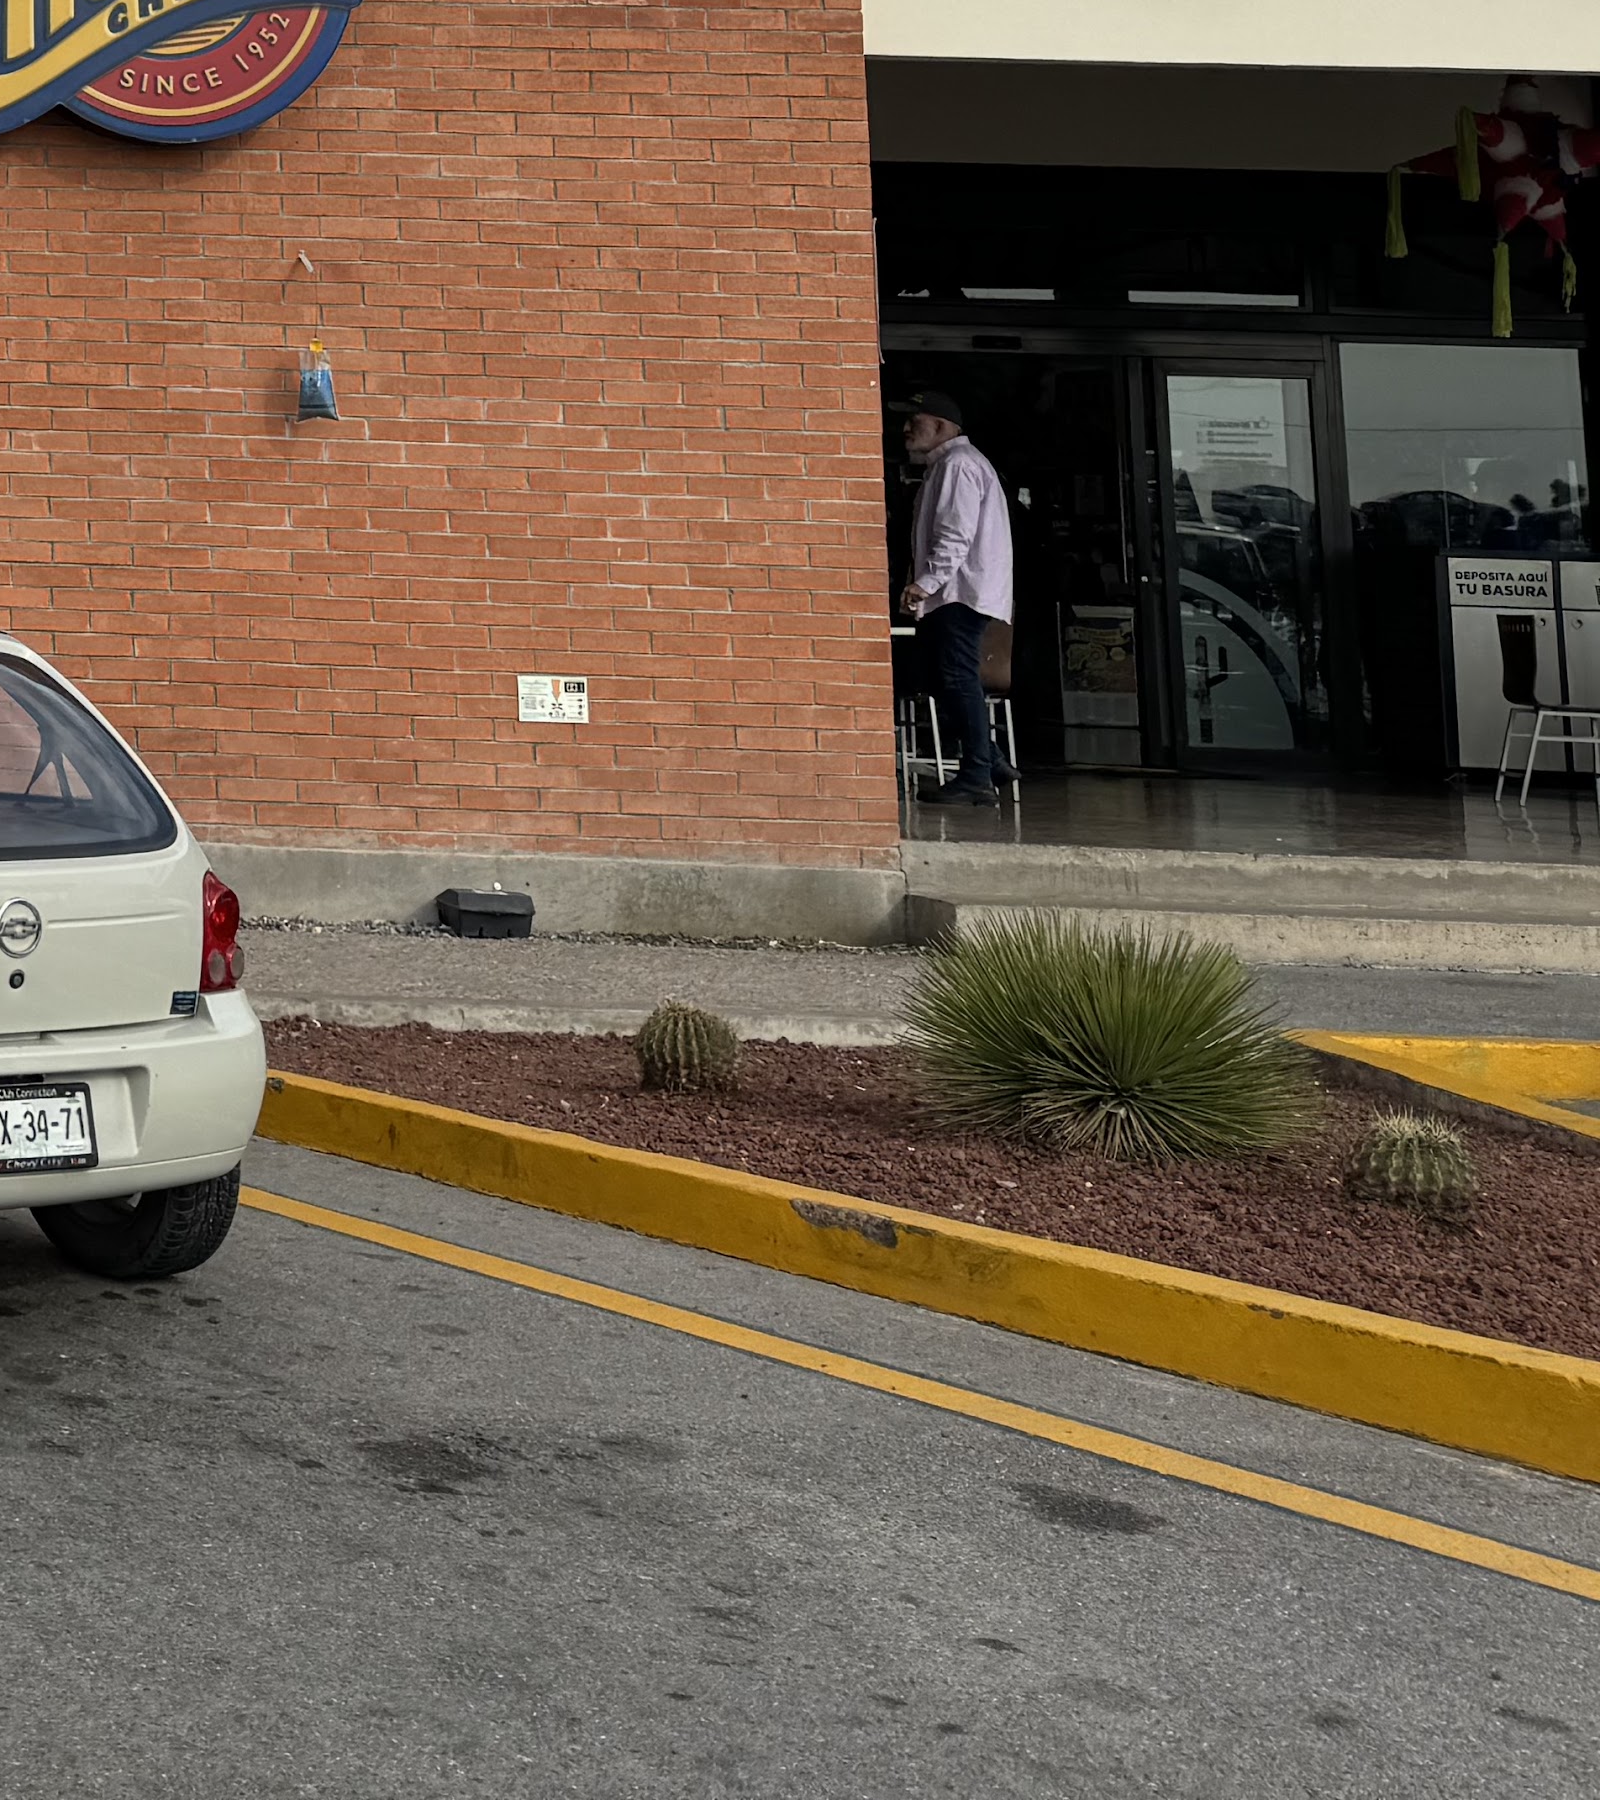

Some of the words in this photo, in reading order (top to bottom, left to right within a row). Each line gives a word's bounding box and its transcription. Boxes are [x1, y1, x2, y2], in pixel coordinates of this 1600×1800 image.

[119, 66, 224, 97] SINCE
[234, 10, 291, 73] 1952
[1455, 571, 1515, 582] DEPOSITA
[1518, 571, 1548, 583] AQUÍ
[1456, 583, 1478, 595] TU
[1482, 584, 1548, 598] BASURA
